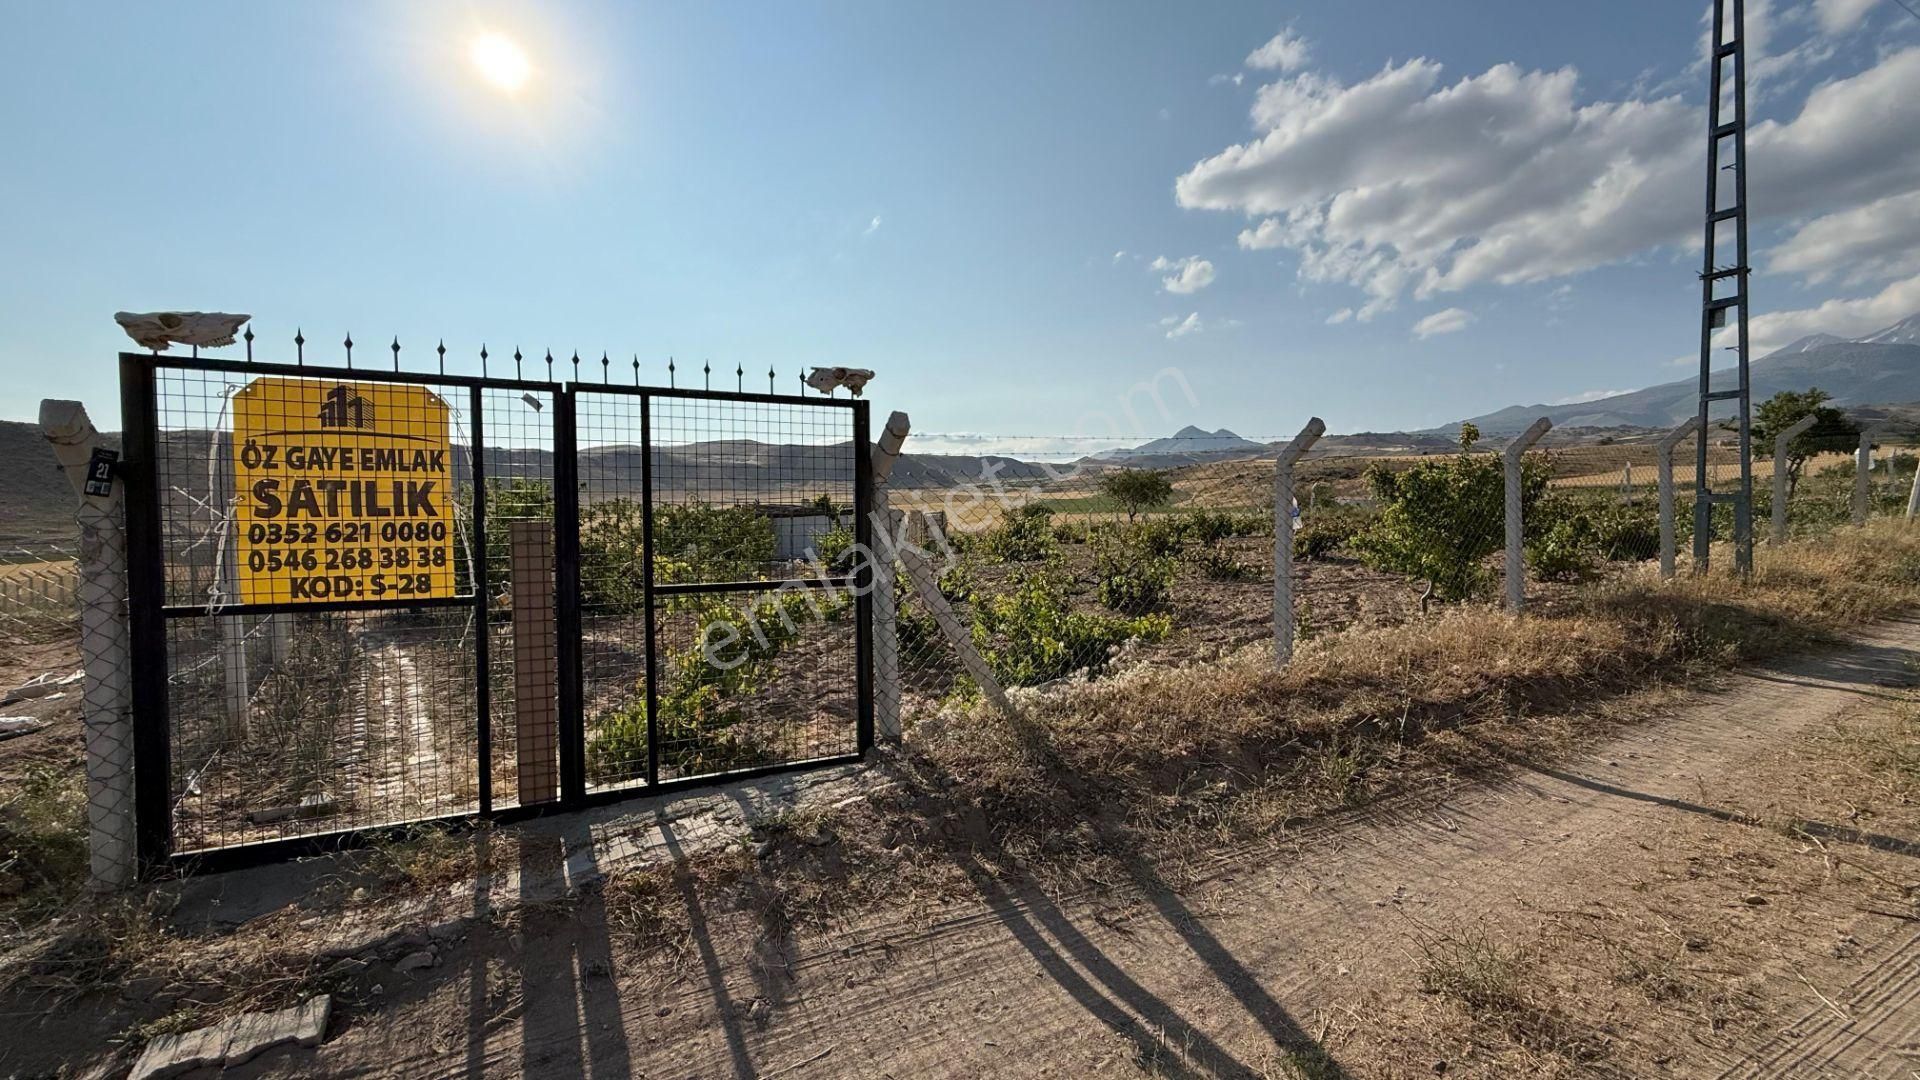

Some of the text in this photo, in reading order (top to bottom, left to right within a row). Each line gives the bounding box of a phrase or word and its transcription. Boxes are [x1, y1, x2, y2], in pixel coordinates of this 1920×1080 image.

[241, 439, 445, 472] ÖZ GAYE EMLAK
[253, 479, 438, 518] SATILIK
[249, 522, 446, 544] 0352 621 0080
[249, 547, 446, 572] 0546 268 38 38
[292, 573, 431, 599] KOD: S-28
